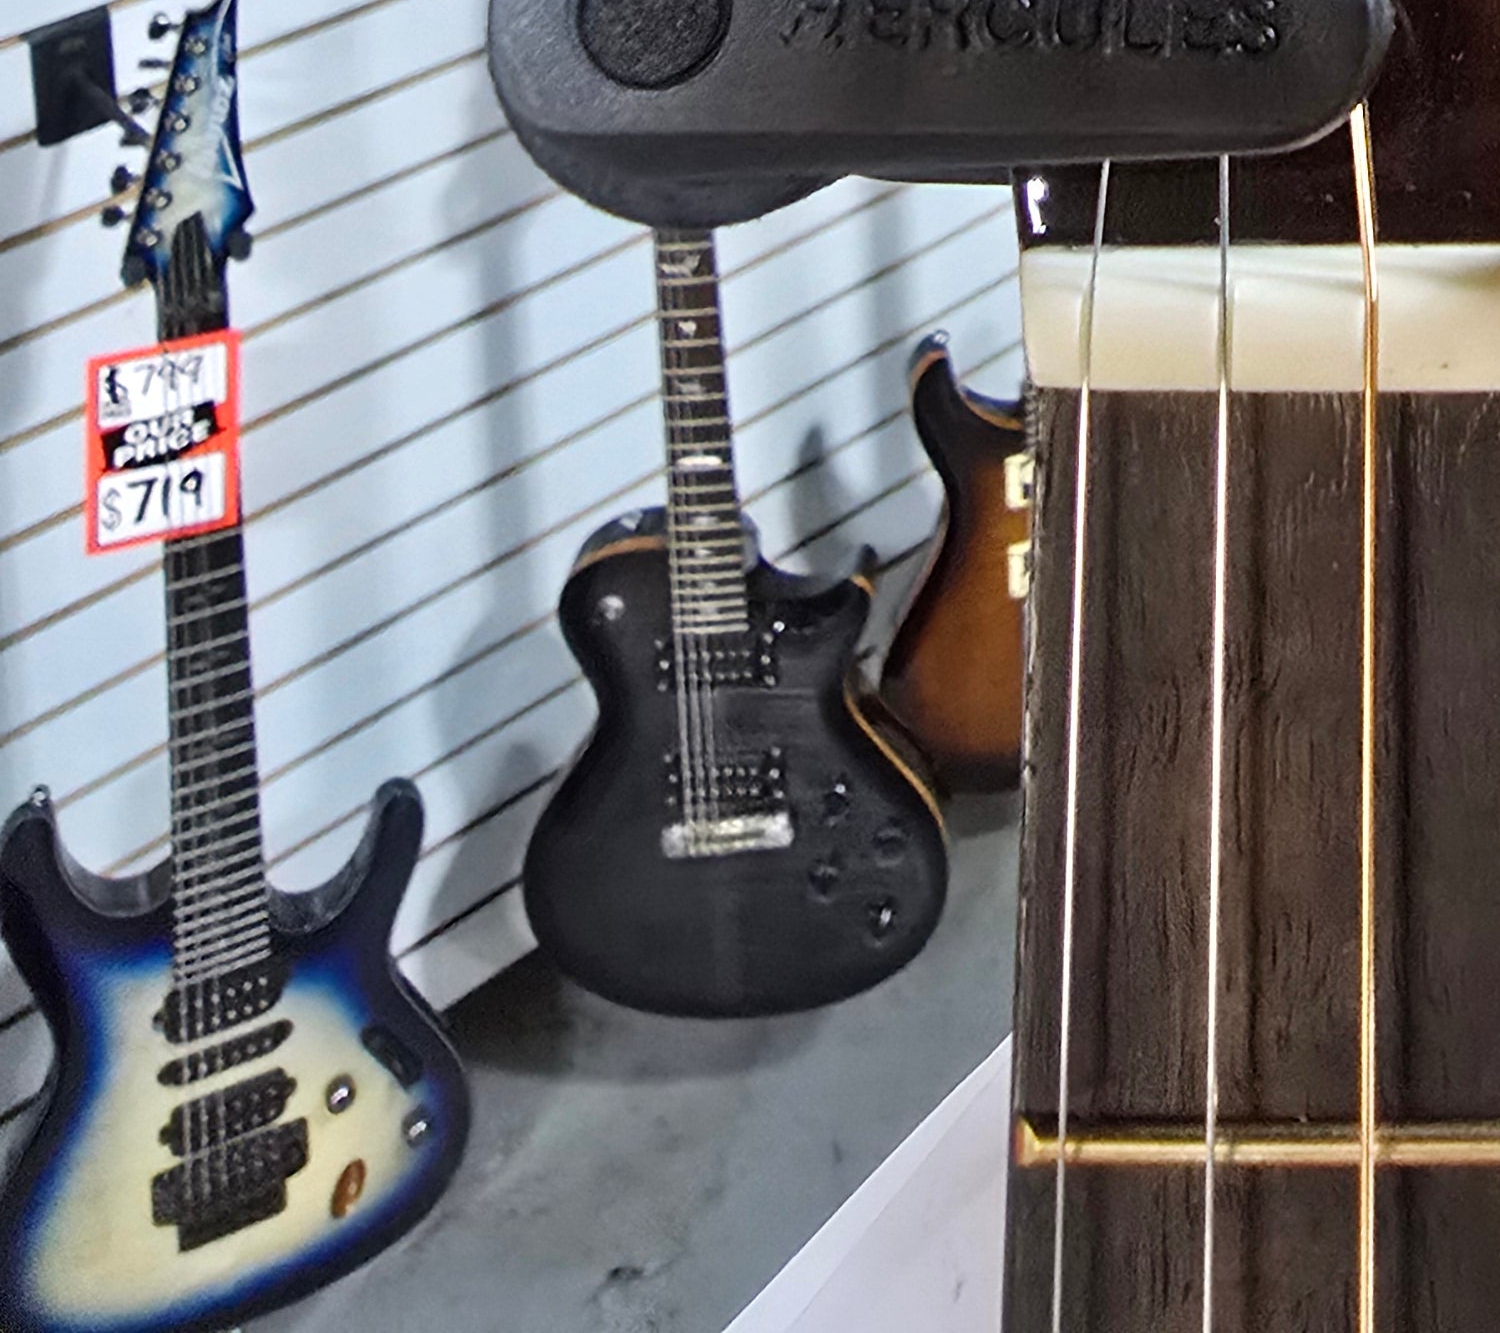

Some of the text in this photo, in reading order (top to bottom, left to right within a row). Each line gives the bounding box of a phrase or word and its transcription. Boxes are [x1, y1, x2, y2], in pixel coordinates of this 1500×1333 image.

[113, 419, 213, 469] PRICE
[123, 407, 195, 446] OUR
[101, 468, 204, 531] $719
